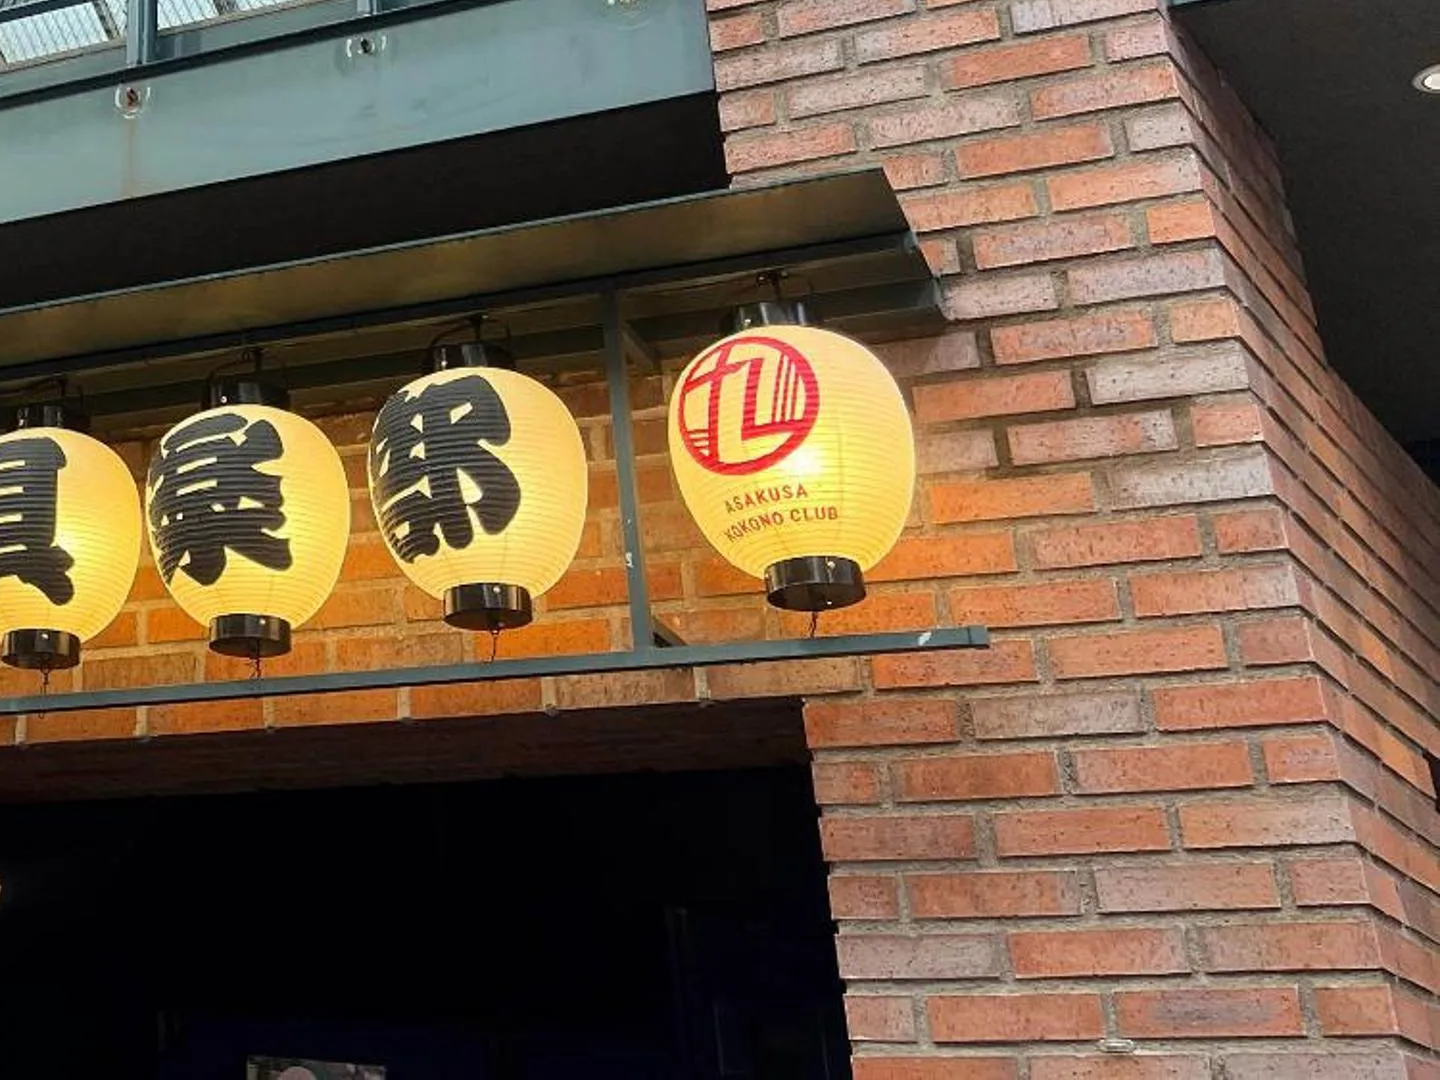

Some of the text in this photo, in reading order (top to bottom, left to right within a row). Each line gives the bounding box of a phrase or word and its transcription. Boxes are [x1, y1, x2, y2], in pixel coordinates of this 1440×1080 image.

[724, 482, 809, 514] ASAKUSA
[723, 506, 839, 544] KOKONO CLUB
